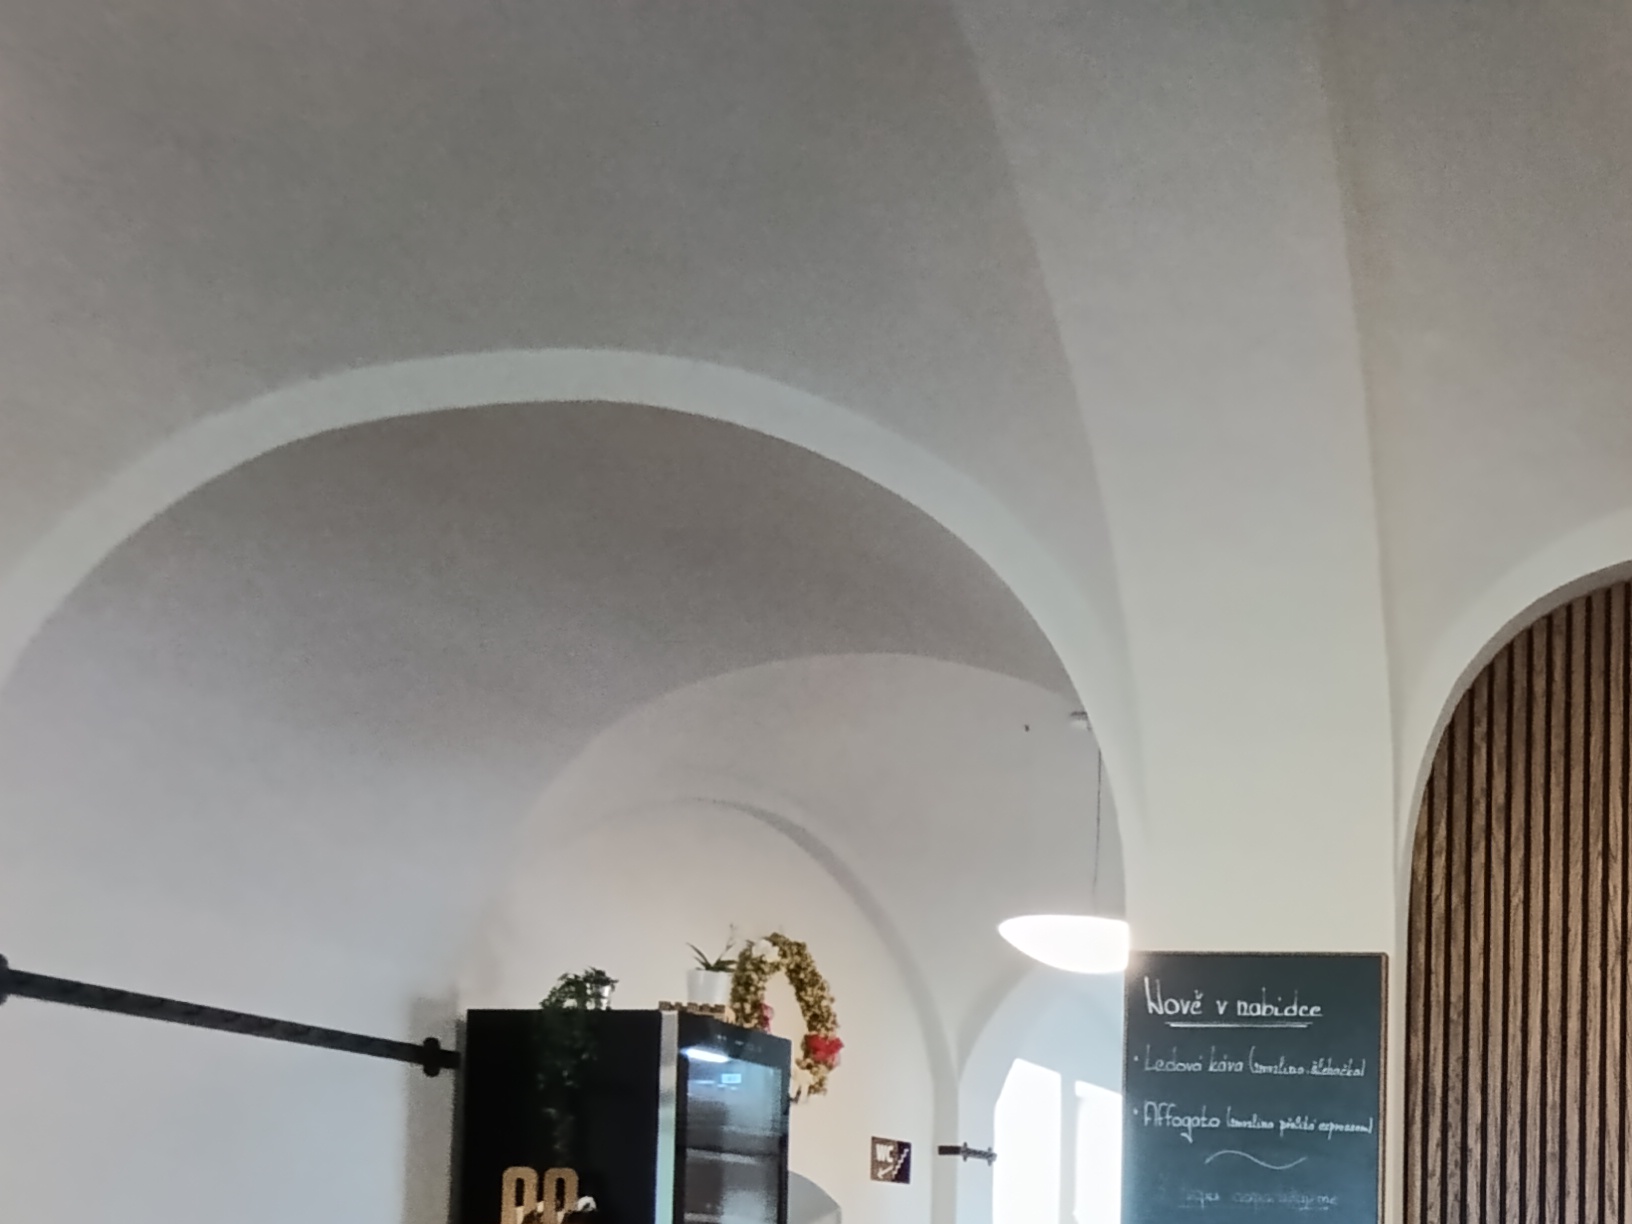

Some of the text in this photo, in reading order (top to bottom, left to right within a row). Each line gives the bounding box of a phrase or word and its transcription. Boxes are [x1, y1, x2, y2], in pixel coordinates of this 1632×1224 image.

[1144, 975, 1203, 1015] Nově
[1216, 1000, 1228, 1015] v
[1144, 1101, 1221, 1143] Affogato
[876, 1143, 894, 1163] WC
